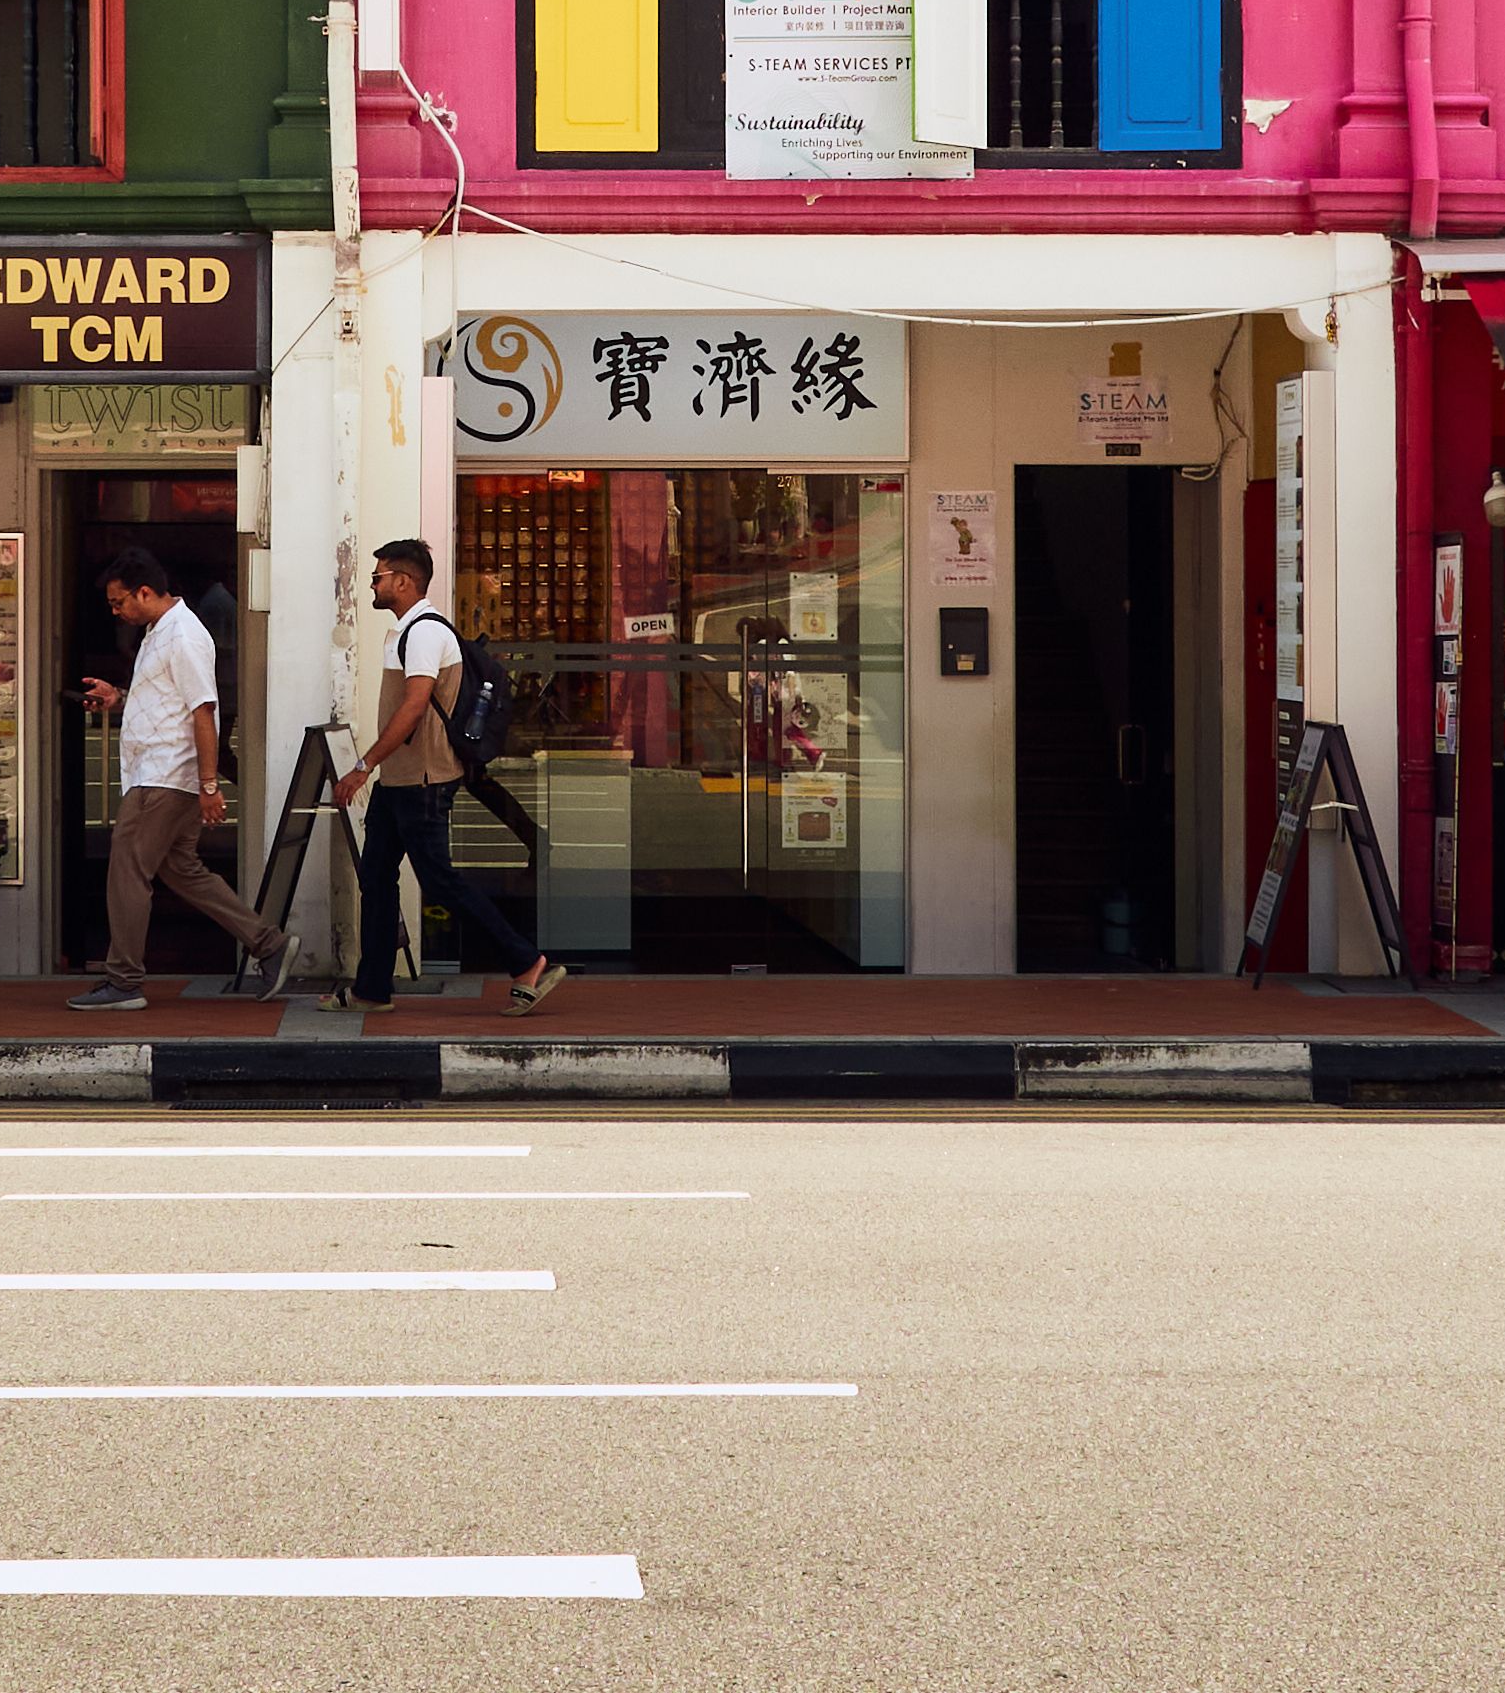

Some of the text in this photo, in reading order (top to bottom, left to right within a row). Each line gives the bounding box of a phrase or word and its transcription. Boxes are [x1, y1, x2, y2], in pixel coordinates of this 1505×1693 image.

[734, 5, 778, 16] Interior
[783, 5, 826, 16] Builder
[843, 5, 883, 17] Project
[749, 58, 807, 71] S-TEAM
[814, 58, 889, 71] SERVICES
[735, 113, 866, 136] Sustainability
[782, 138, 863, 149] Enriching Lives
[813, 149, 968, 161] Supporting our Environment
[31, 315, 163, 363] TCM
[593, 330, 878, 422] 寶濟緣
[1080, 393, 1167, 410] S-TEAM
[51, 439, 227, 448] HAIR SALON
[631, 619, 667, 633] OPEN
